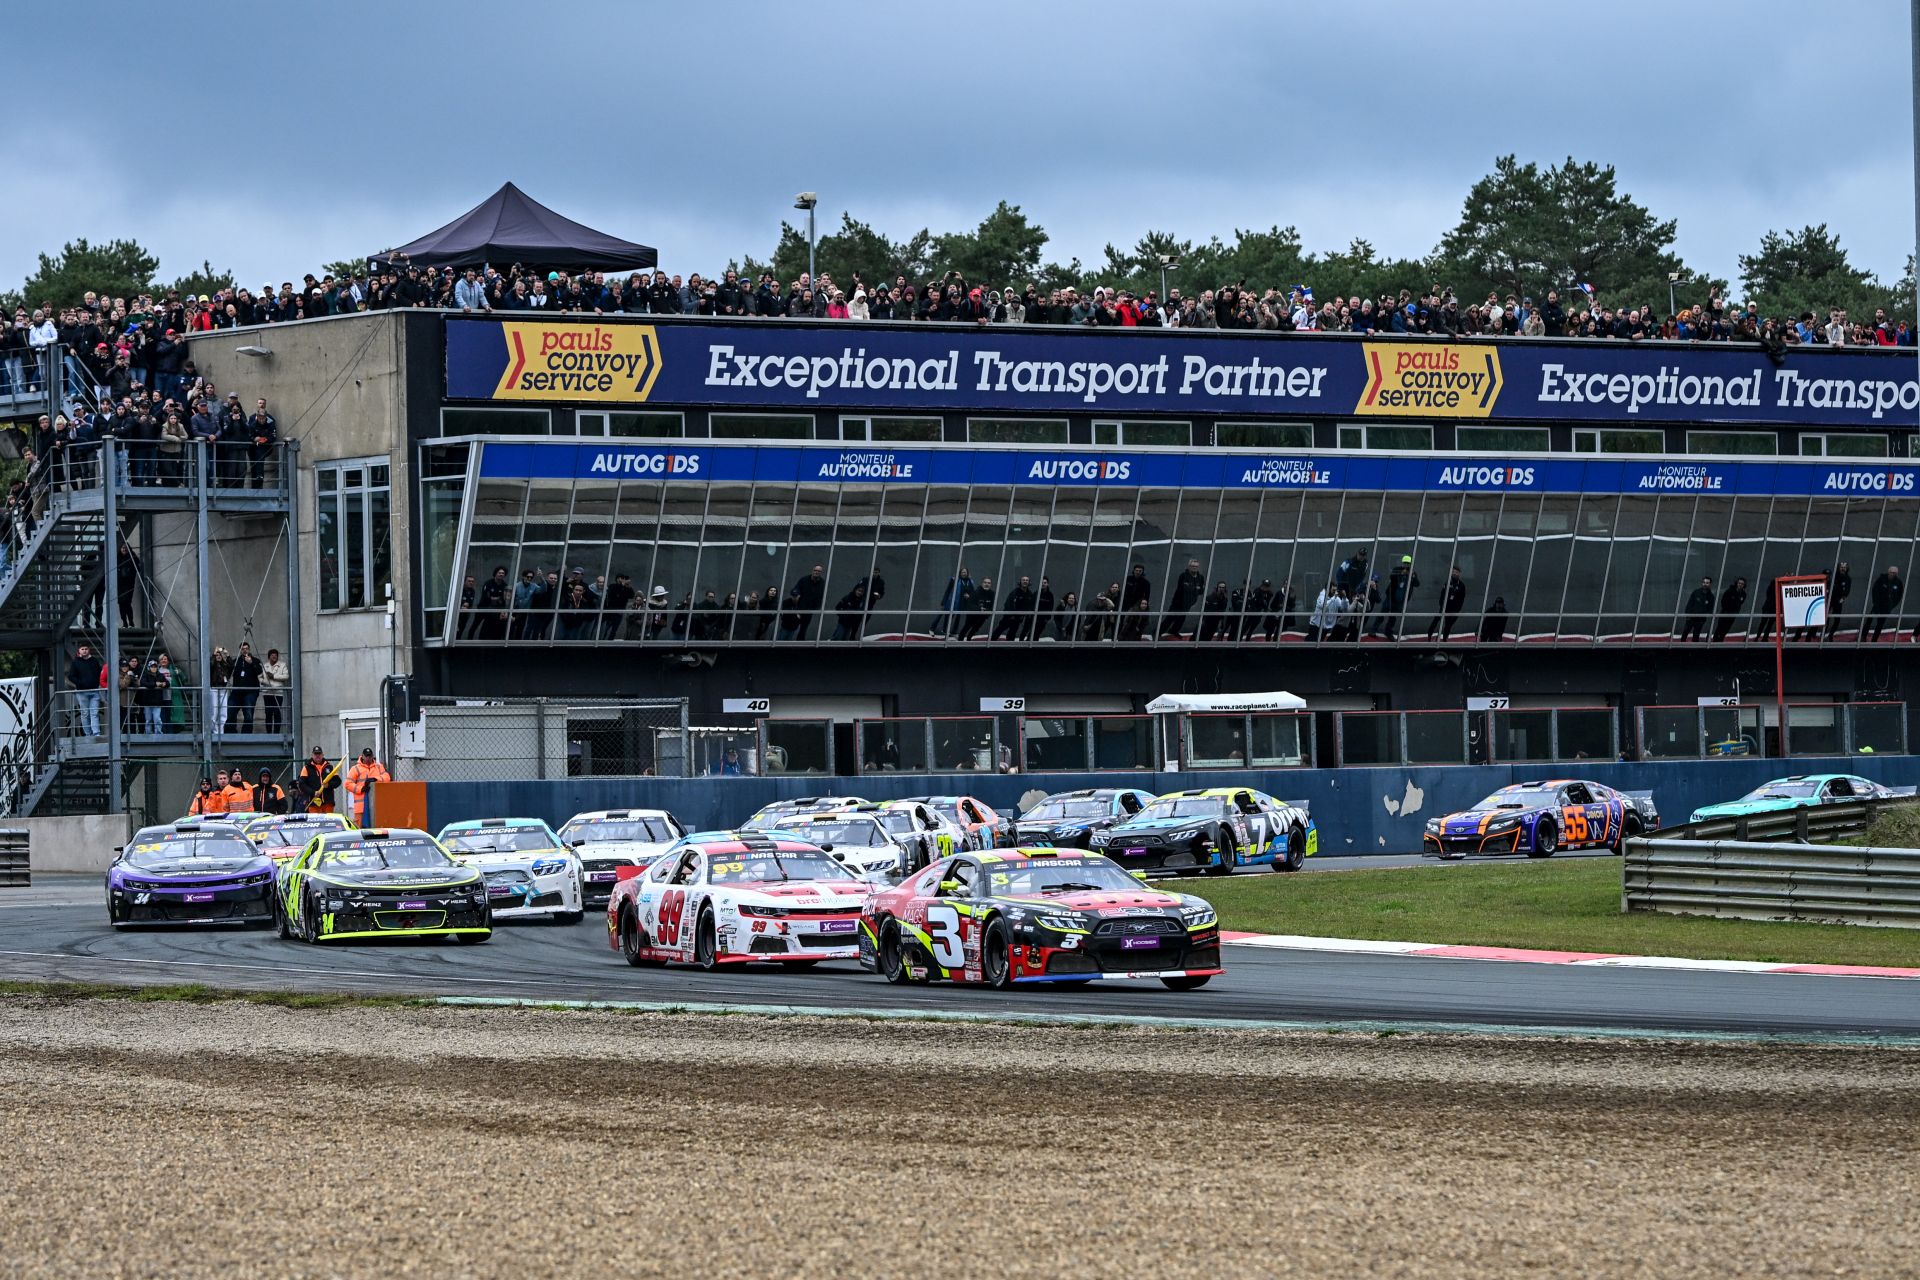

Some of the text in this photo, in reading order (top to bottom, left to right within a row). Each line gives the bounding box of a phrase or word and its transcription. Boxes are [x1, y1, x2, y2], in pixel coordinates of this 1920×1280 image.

[540, 328, 613, 356] pauls
[547, 352, 641, 378] convoy
[1395, 348, 1460, 374] pauls
[704, 344, 1328, 402] Exceptional Transport Partner
[520, 372, 613, 392] service
[1401, 371, 1485, 395] convoy
[1538, 363, 1763, 413] Exceptional
[1379, 389, 1460, 408] service
[840, 454, 895, 464] MONITEUR
[1262, 460, 1314, 471] MONITEUR
[1657, 466, 1707, 477] MONITEUR
[1784, 585, 1823, 598] PROFICLEAN
[747, 700, 768, 711] 40
[1004, 699, 1024, 710] 39
[1210, 702, 1278, 711] www.raceplanet.nl
[1489, 699, 1508, 709] 37
[409, 730, 416, 743] 1
[1561, 805, 1589, 841] 55
[176, 832, 215, 840] NASCAR
[477, 827, 519, 835] NASCAR
[1251, 818, 1266, 855] 7
[363, 840, 407, 848] NASCAR
[750, 852, 798, 860] NASCAR
[135, 893, 150, 905] 34
[657, 889, 685, 946] 99
[751, 920, 767, 933] 99
[927, 906, 966, 968] 3
[1060, 933, 1084, 949] 3
